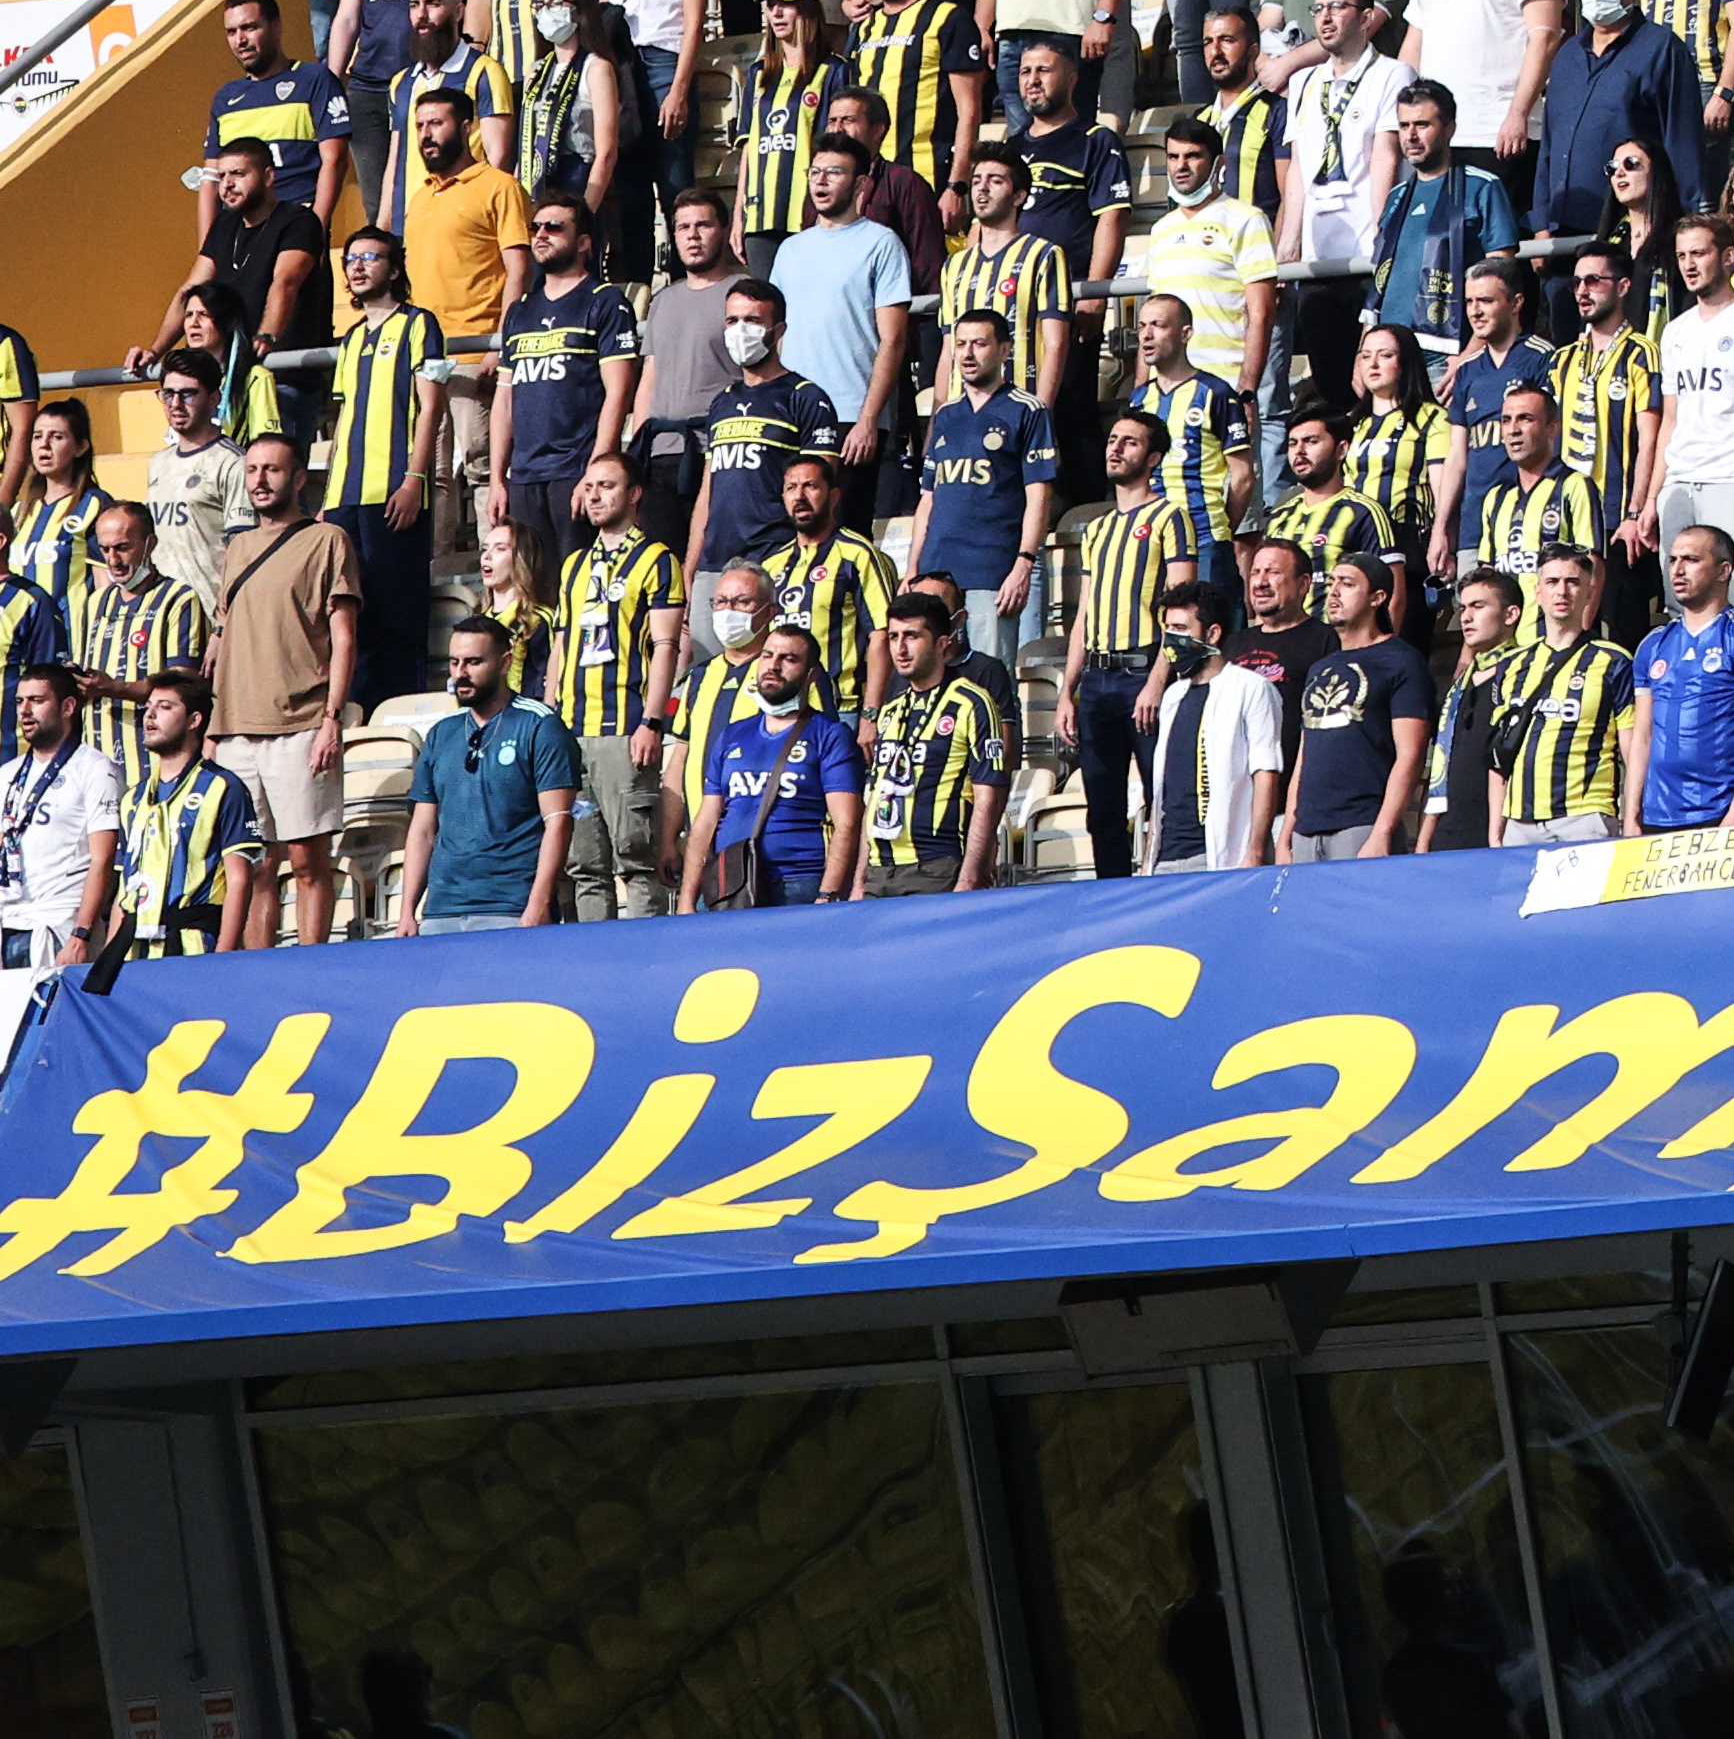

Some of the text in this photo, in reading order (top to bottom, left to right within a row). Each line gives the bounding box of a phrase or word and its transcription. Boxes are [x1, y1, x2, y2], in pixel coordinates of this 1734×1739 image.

[758, 133, 796, 153] avea
[512, 356, 566, 382] AVIS
[1677, 366, 1722, 394] AVIS
[934, 459, 991, 486] AVIS
[729, 772, 799, 798] AVS
